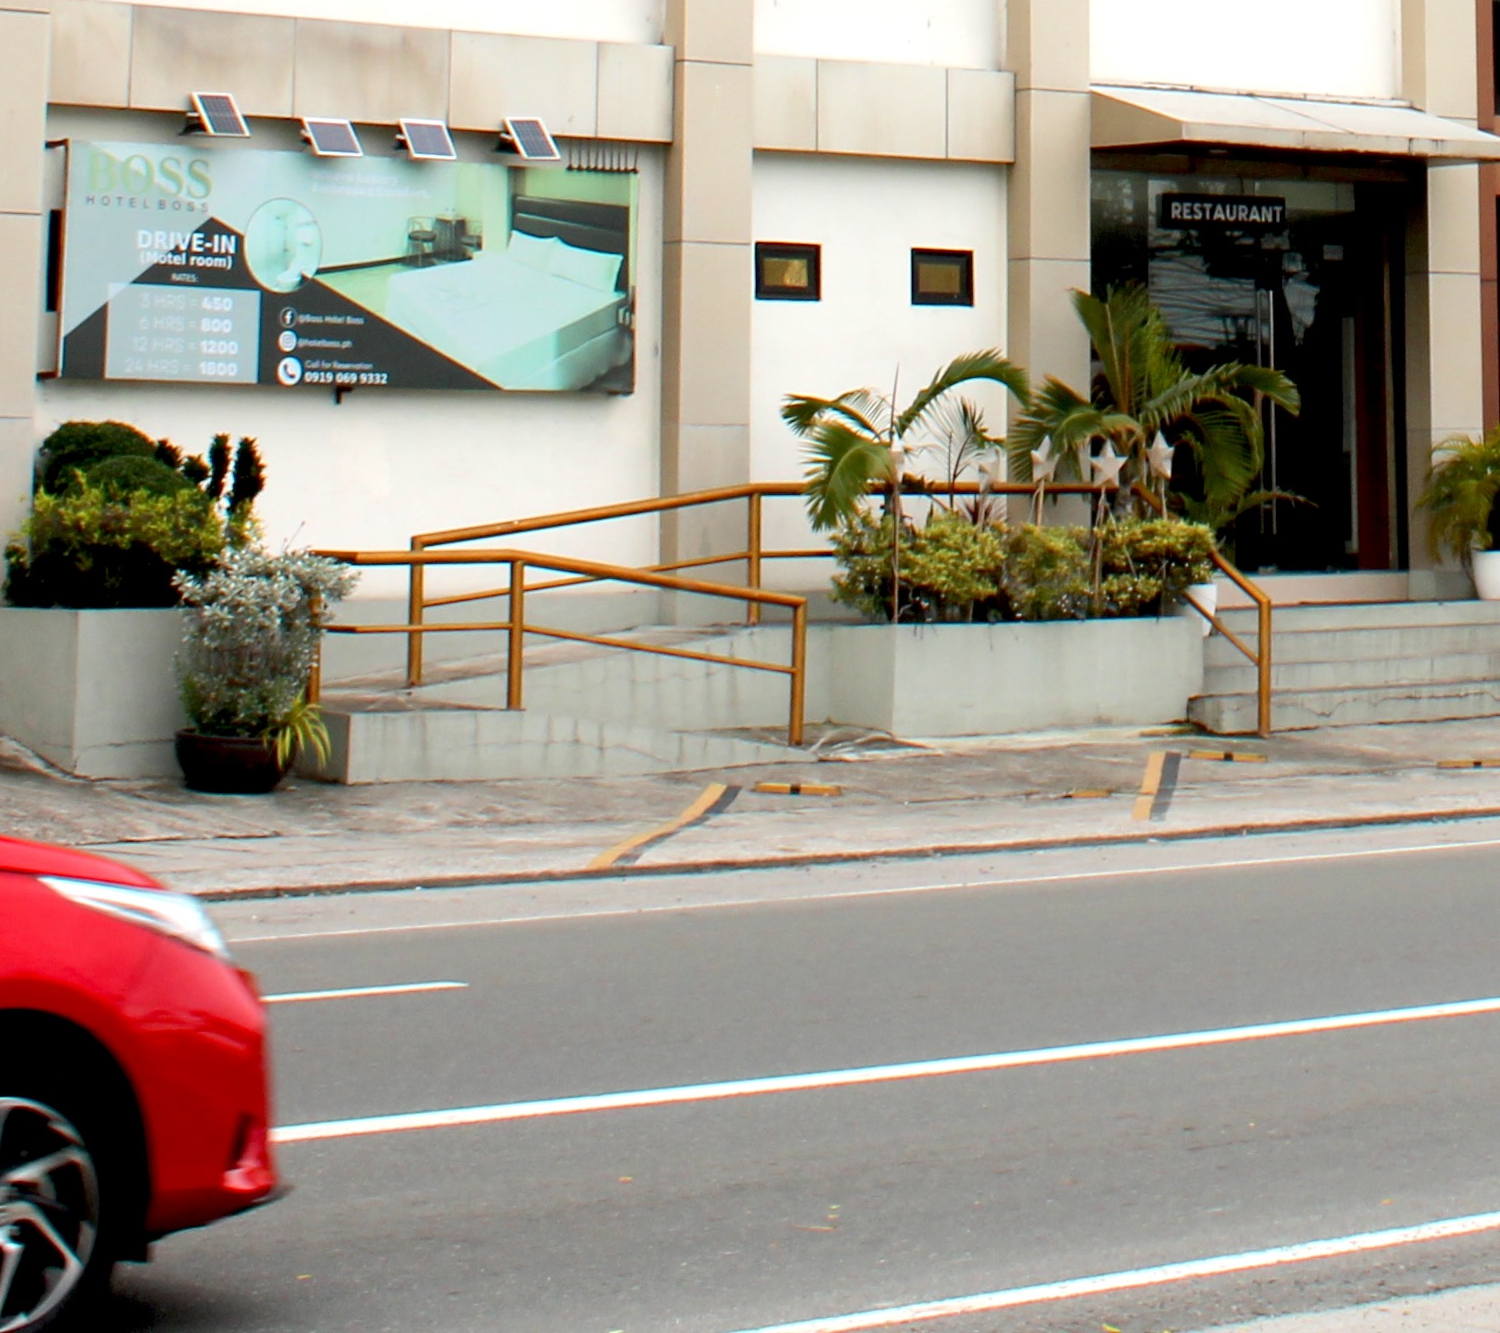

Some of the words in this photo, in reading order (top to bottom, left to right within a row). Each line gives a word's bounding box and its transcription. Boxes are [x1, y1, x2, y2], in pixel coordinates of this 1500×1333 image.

[88, 150, 213, 200] BOSS
[86, 195, 151, 210] HOTEL
[158, 200, 210, 213] BOSS
[1171, 201, 1283, 223] RESTAURANT
[137, 229, 237, 254] DRIVE-IN
[140, 250, 187, 267] (Motel
[189, 254, 233, 270] room)
[201, 296, 234, 312] 450
[201, 317, 233, 333] 800
[201, 339, 239, 355] 1200
[199, 361, 238, 376] 1800
[304, 372, 333, 383] 0919
[359, 373, 388, 384] 9332
